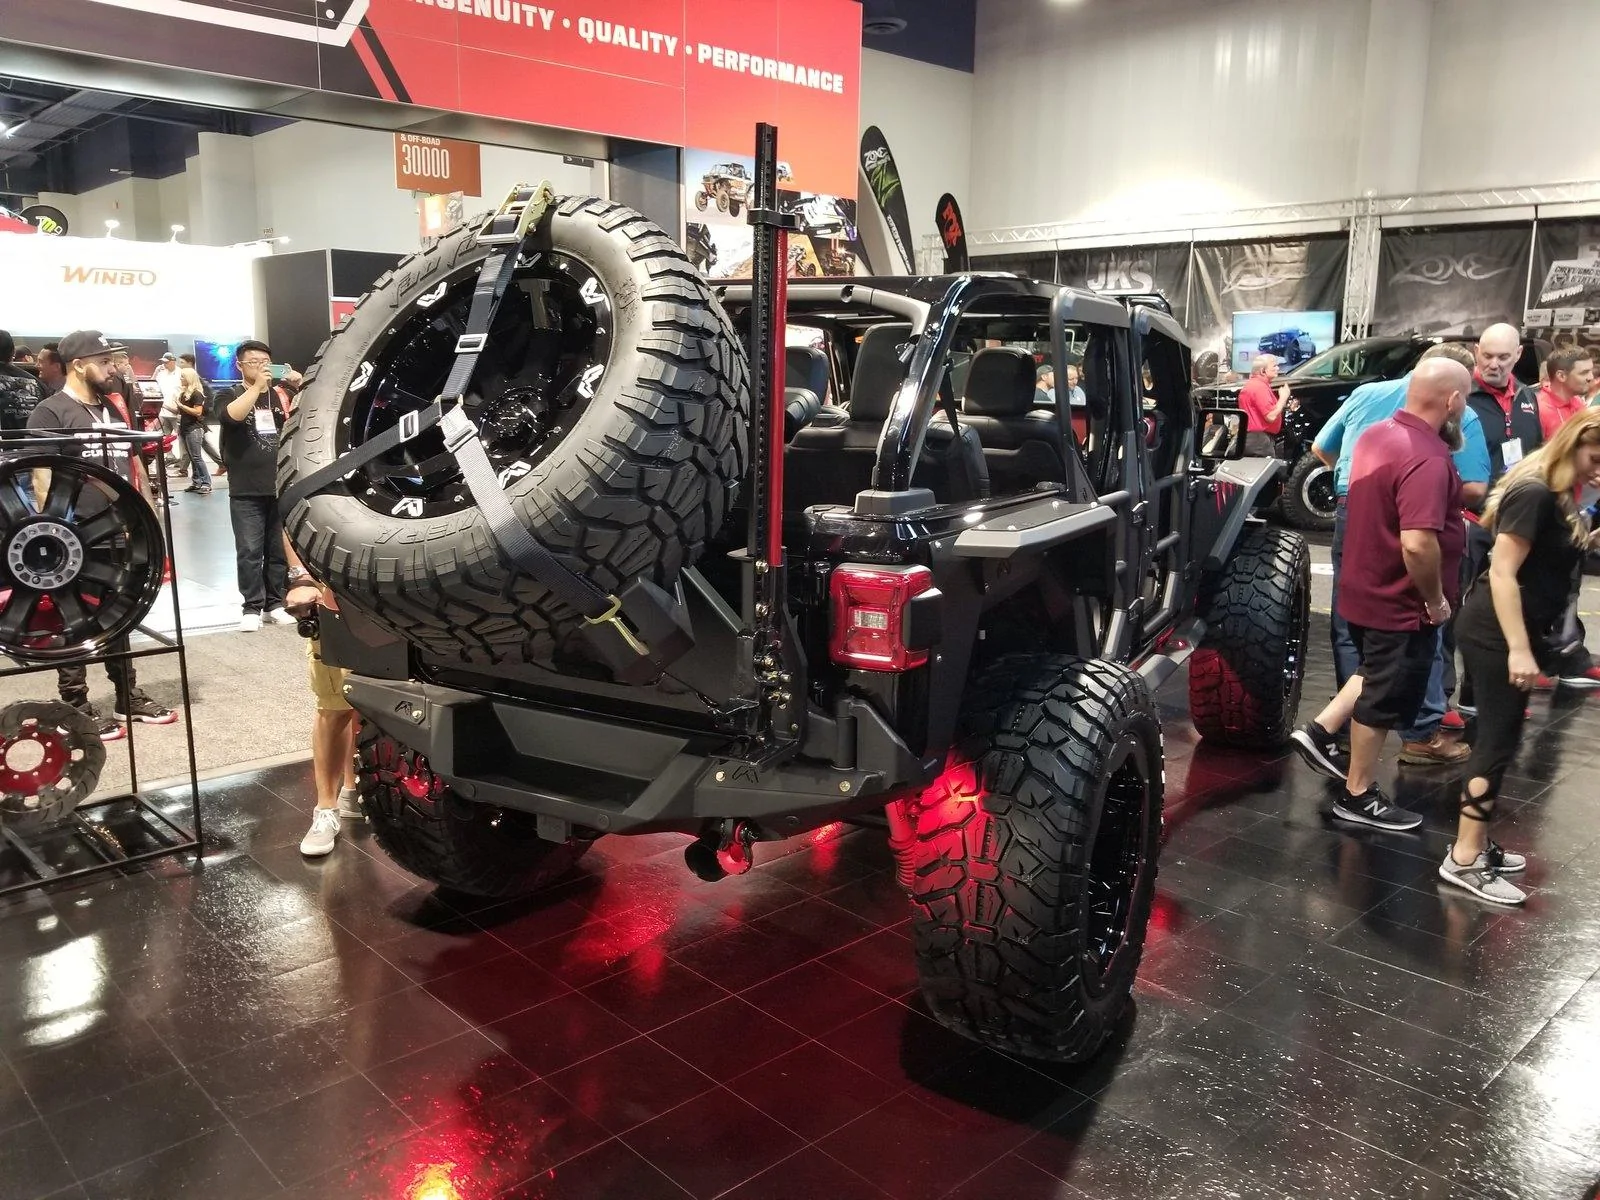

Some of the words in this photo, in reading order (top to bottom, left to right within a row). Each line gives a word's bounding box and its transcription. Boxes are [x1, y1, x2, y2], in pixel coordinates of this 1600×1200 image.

[409, 0, 555, 30] ENUITY
[578, 16, 678, 57] QUALITY
[697, 43, 844, 94] PERFORMANCE
[407, 134, 441, 146] OFF-ROAD
[402, 144, 450, 180] 30000
[60, 265, 157, 286] WINBO
[1086, 259, 1153, 294] JKS
[1363, 800, 1388, 816] N
